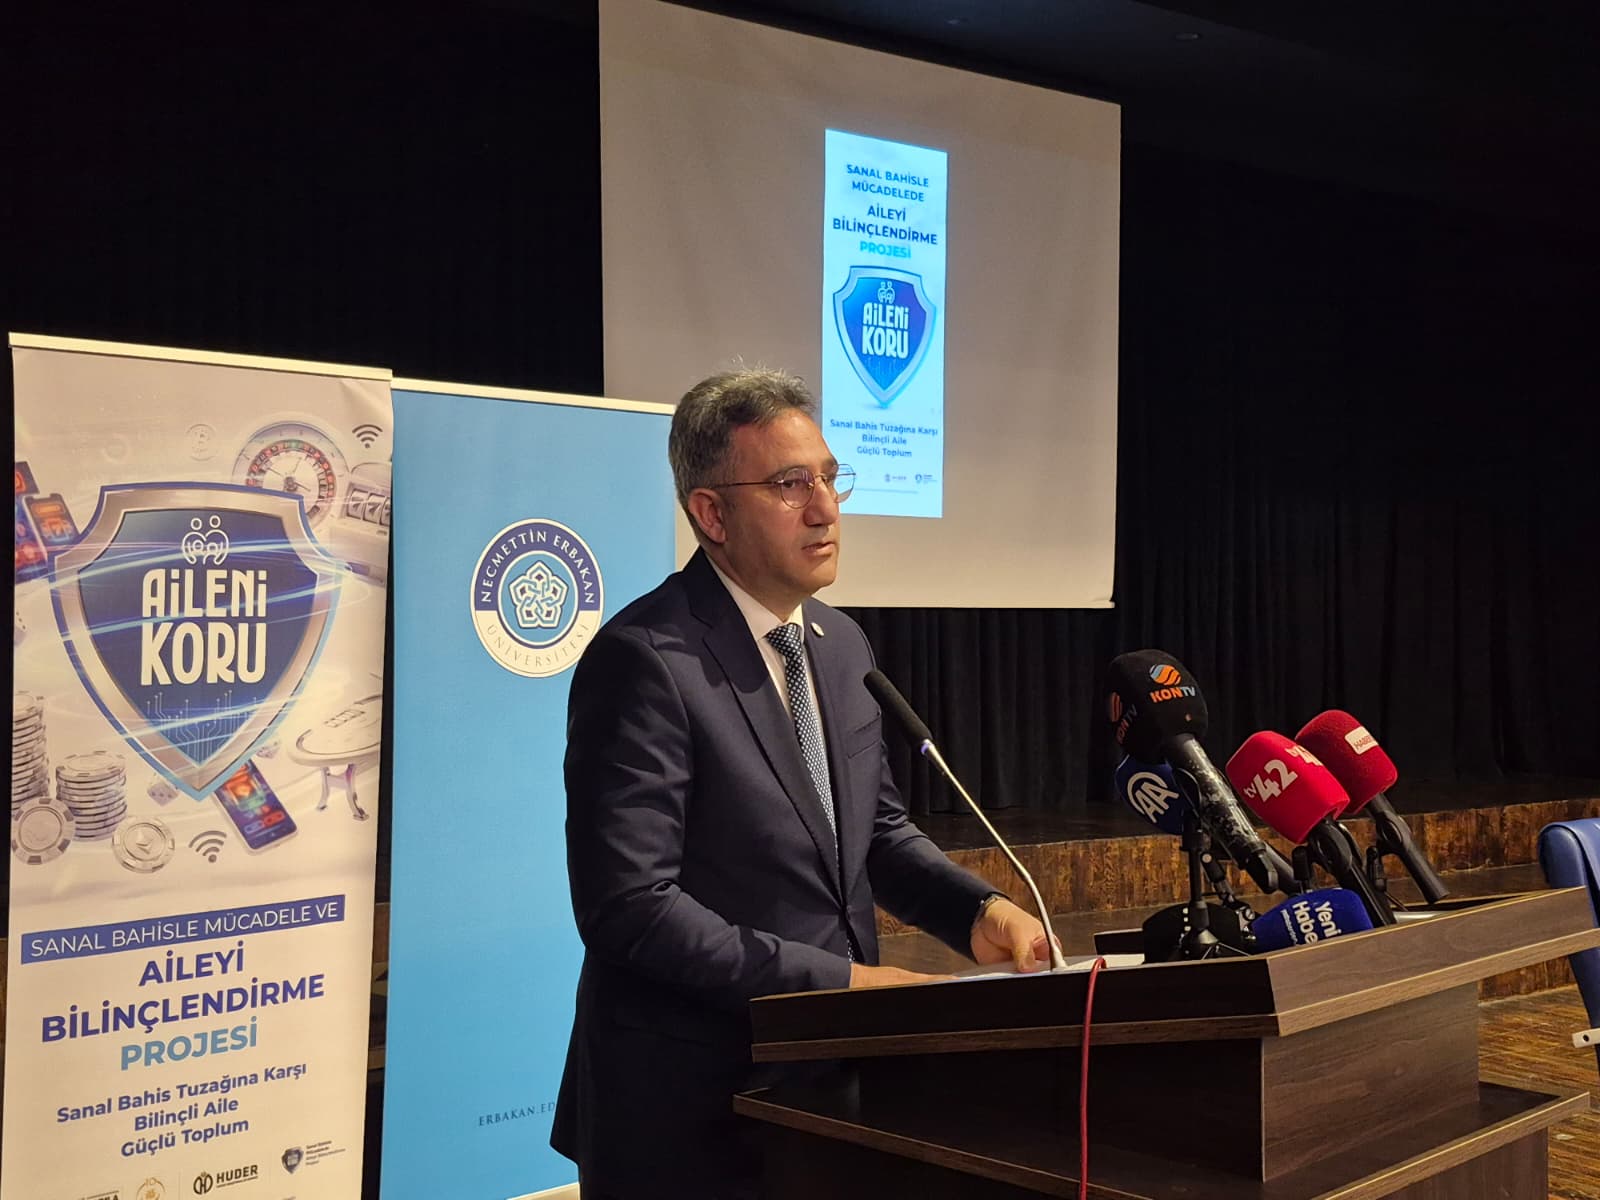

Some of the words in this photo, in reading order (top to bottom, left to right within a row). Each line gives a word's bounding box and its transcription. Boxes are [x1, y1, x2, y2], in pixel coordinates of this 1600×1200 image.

[846, 164, 882, 180] SANAL
[885, 168, 929, 188] BAHİSLE
[852, 179, 925, 202] MÜCADELEDE
[867, 204, 907, 223] AİLEYİ
[833, 217, 938, 245] BİLİNÇLENDİRME
[859, 240, 912, 260] PROJESİ
[861, 328, 909, 359] KORU
[830, 418, 853, 431] Sanal
[855, 420, 878, 432] Bahis
[862, 433, 889, 447] Bilinçli
[890, 434, 908, 446] Aile
[856, 445, 881, 459] Güçlü
[882, 448, 912, 459] Toplum
[481, 528, 548, 603] NECMETTİN
[553, 535, 596, 604] ERBAKAN
[140, 621, 267, 686] KORU
[1150, 686, 1196, 703] KONTV
[1243, 759, 1298, 803] tv42
[31, 934, 105, 957] SANAL
[112, 917, 199, 947] BAHİSLE
[204, 904, 311, 935] MÜCADELE
[314, 901, 339, 919] VE
[1315, 900, 1343, 938] Yeni
[138, 940, 245, 987] AİLEYİ
[41, 974, 326, 1043] BİLİNÇLENDİRME
[121, 1016, 258, 1071] PROJESİ
[56, 1098, 112, 1123] Sanal
[118, 1088, 172, 1112] Bahis
[176, 1071, 259, 1101] Tuzağına
[264, 1061, 307, 1086] Karşı
[134, 1107, 199, 1132] Bilinçli
[204, 1098, 239, 1118] Aile
[121, 1131, 176, 1158] Güçlü
[182, 1118, 249, 1146] Toplum
[216, 1165, 259, 1185] HUDER
